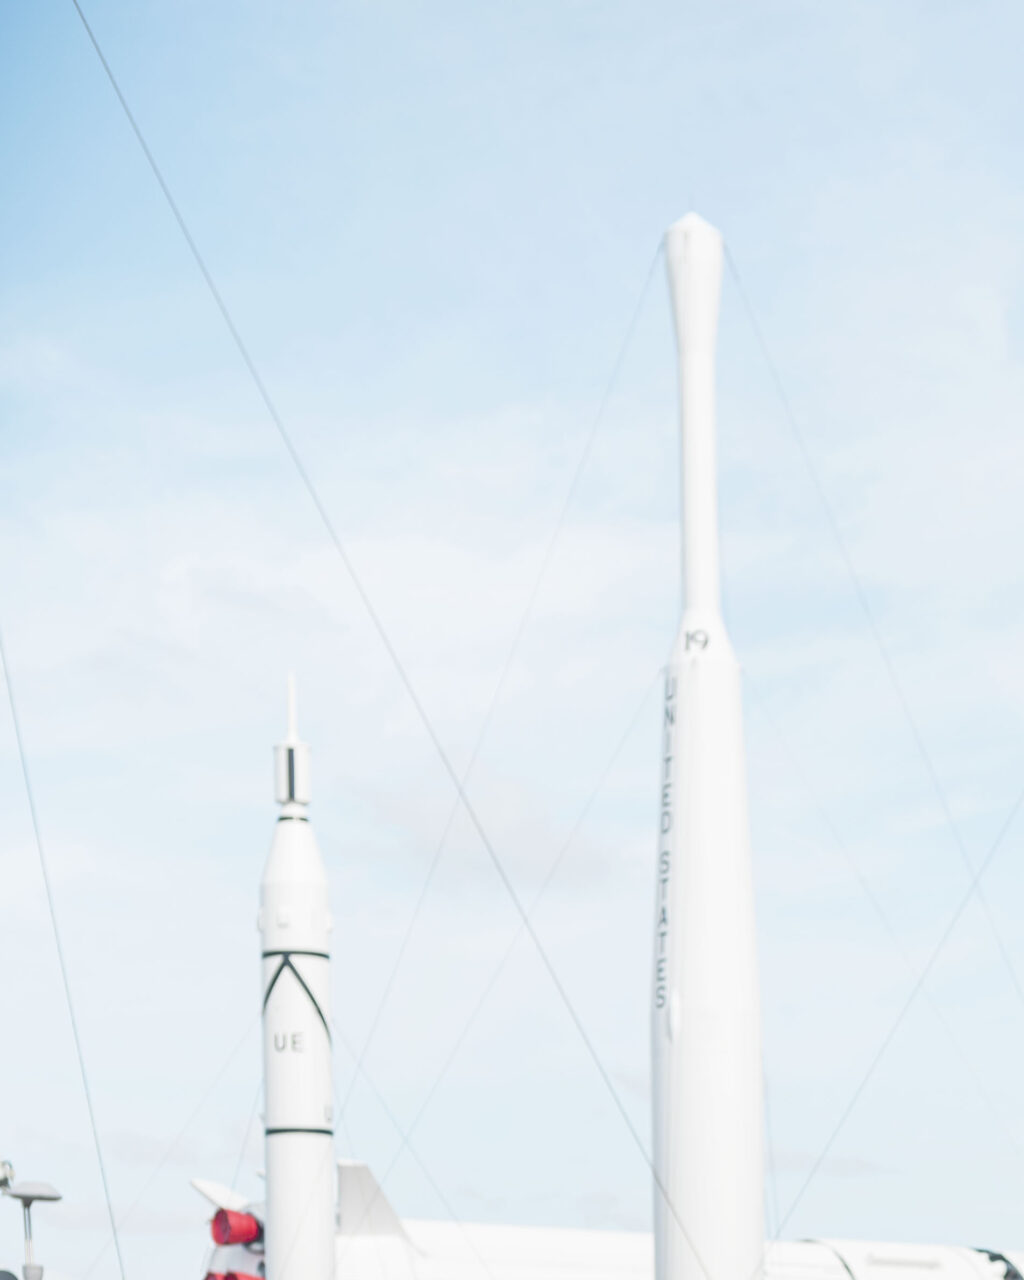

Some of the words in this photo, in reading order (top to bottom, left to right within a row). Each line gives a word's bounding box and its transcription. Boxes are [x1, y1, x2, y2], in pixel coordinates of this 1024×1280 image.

[683, 628, 709, 652] 19
[661, 676, 677, 835] UNITED
[655, 849, 670, 1009] STATES
[273, 1032, 304, 1052] UE
